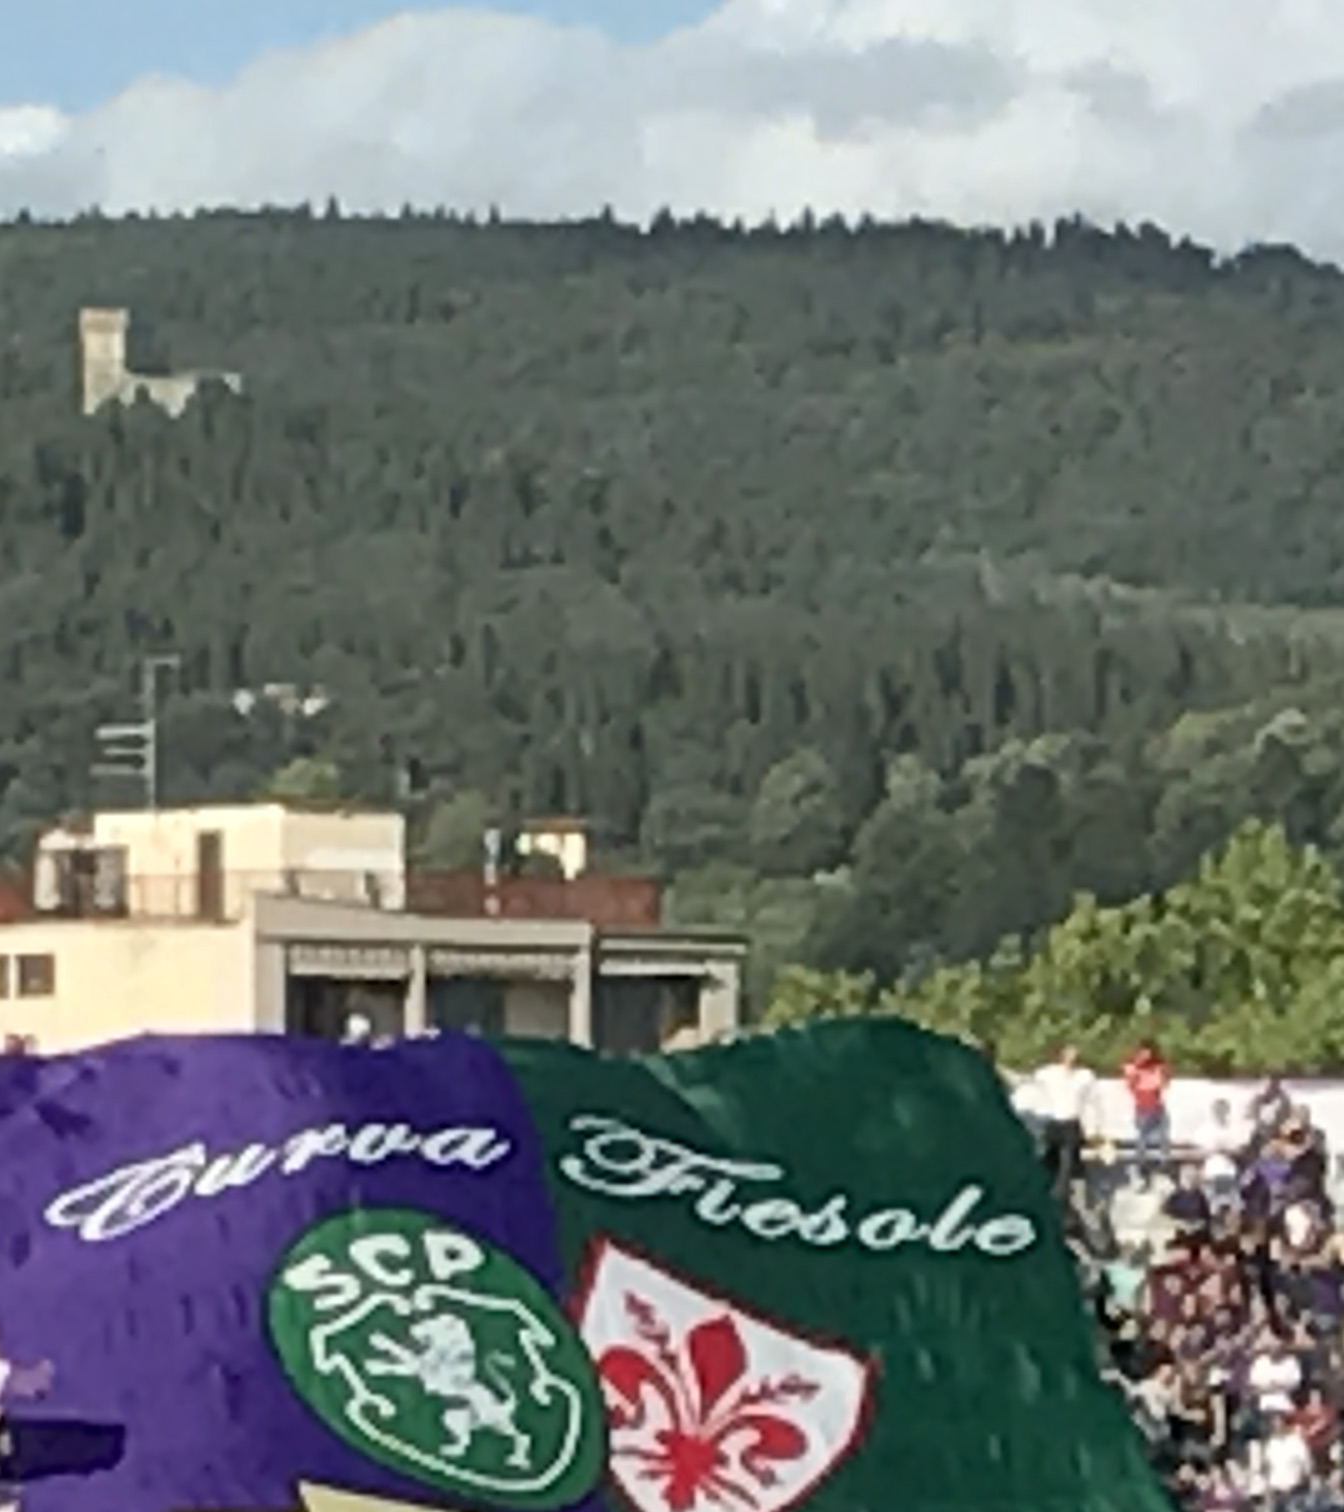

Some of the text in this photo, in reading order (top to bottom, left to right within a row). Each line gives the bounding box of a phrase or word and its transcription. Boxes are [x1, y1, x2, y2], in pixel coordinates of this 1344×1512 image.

[44, 1114, 1038, 1255] Curva Fiesole
[283, 1229, 485, 1311] SCP
